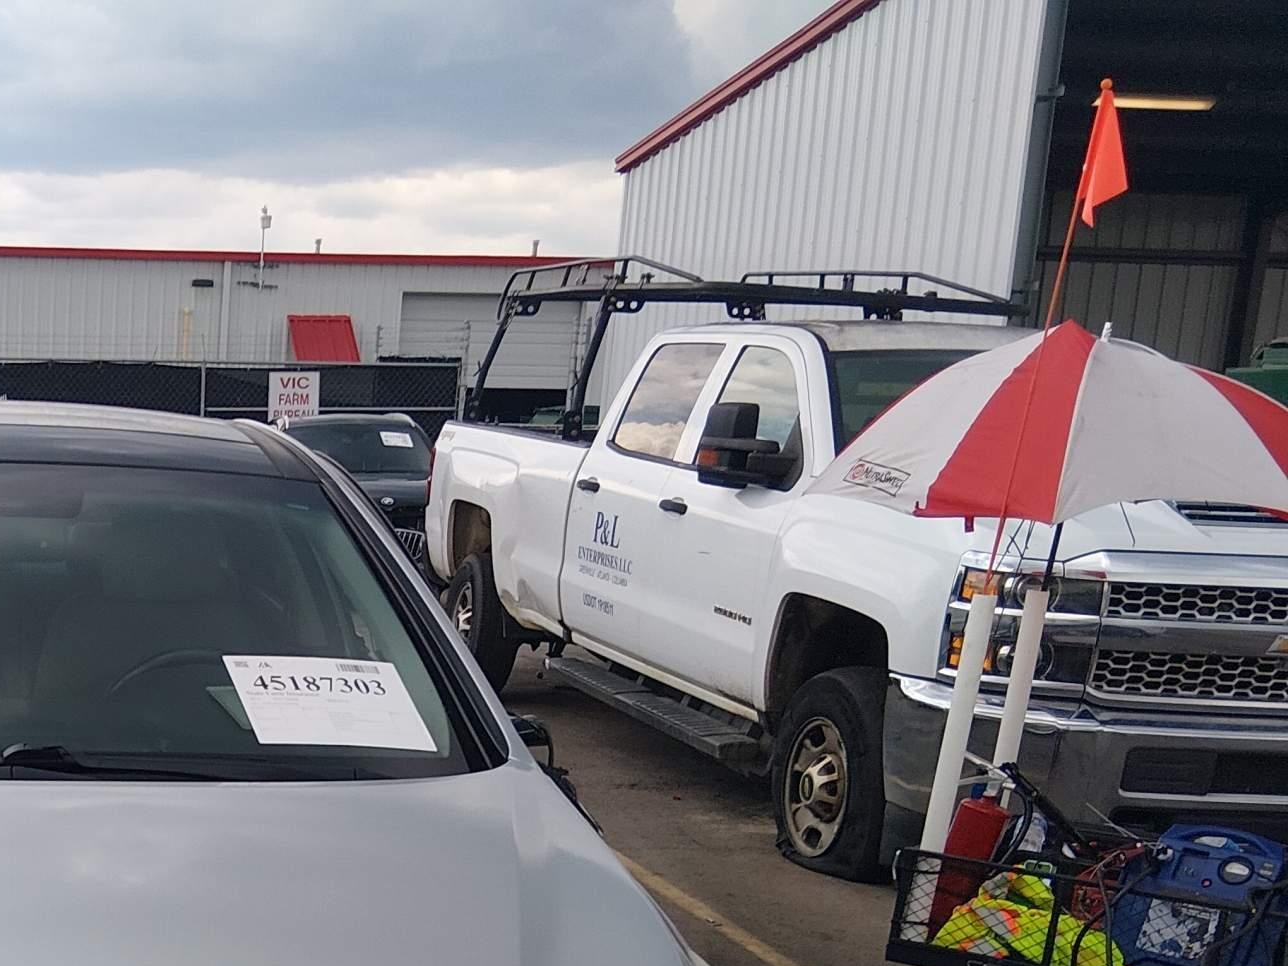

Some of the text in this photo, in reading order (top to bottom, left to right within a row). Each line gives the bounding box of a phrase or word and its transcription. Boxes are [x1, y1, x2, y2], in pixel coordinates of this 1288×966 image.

[280, 376, 309, 389] VIC
[278, 393, 310, 406] FARM
[593, 511, 620, 549] P&L
[578, 545, 633, 575] ENTERPRISES LLC
[253, 675, 387, 696] 45187303
